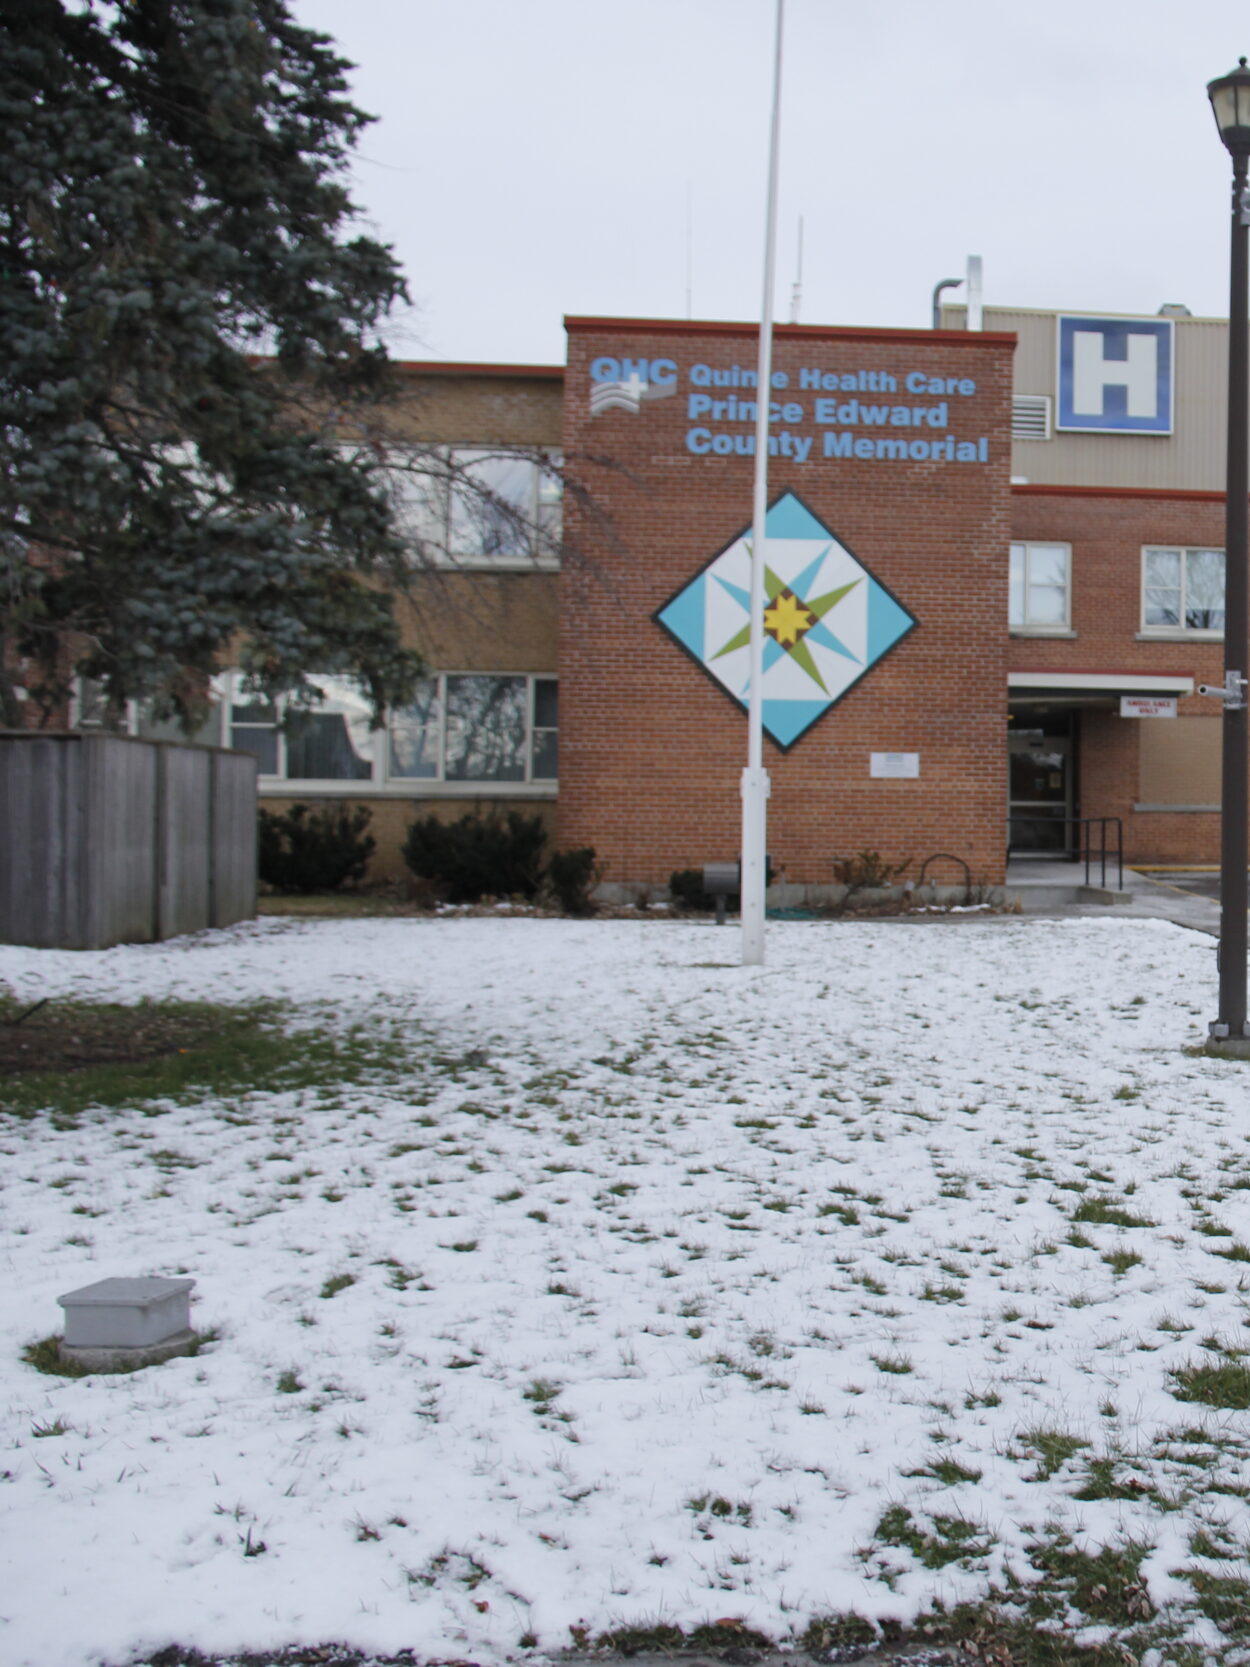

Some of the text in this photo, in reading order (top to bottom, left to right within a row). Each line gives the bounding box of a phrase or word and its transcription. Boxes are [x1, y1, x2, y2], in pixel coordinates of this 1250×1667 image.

[590, 356, 678, 386] QHC
[689, 363, 976, 396] Quine Health Care
[1073, 331, 1158, 419] H
[688, 393, 948, 428] Prince Edward
[823, 431, 989, 463] Memorial
